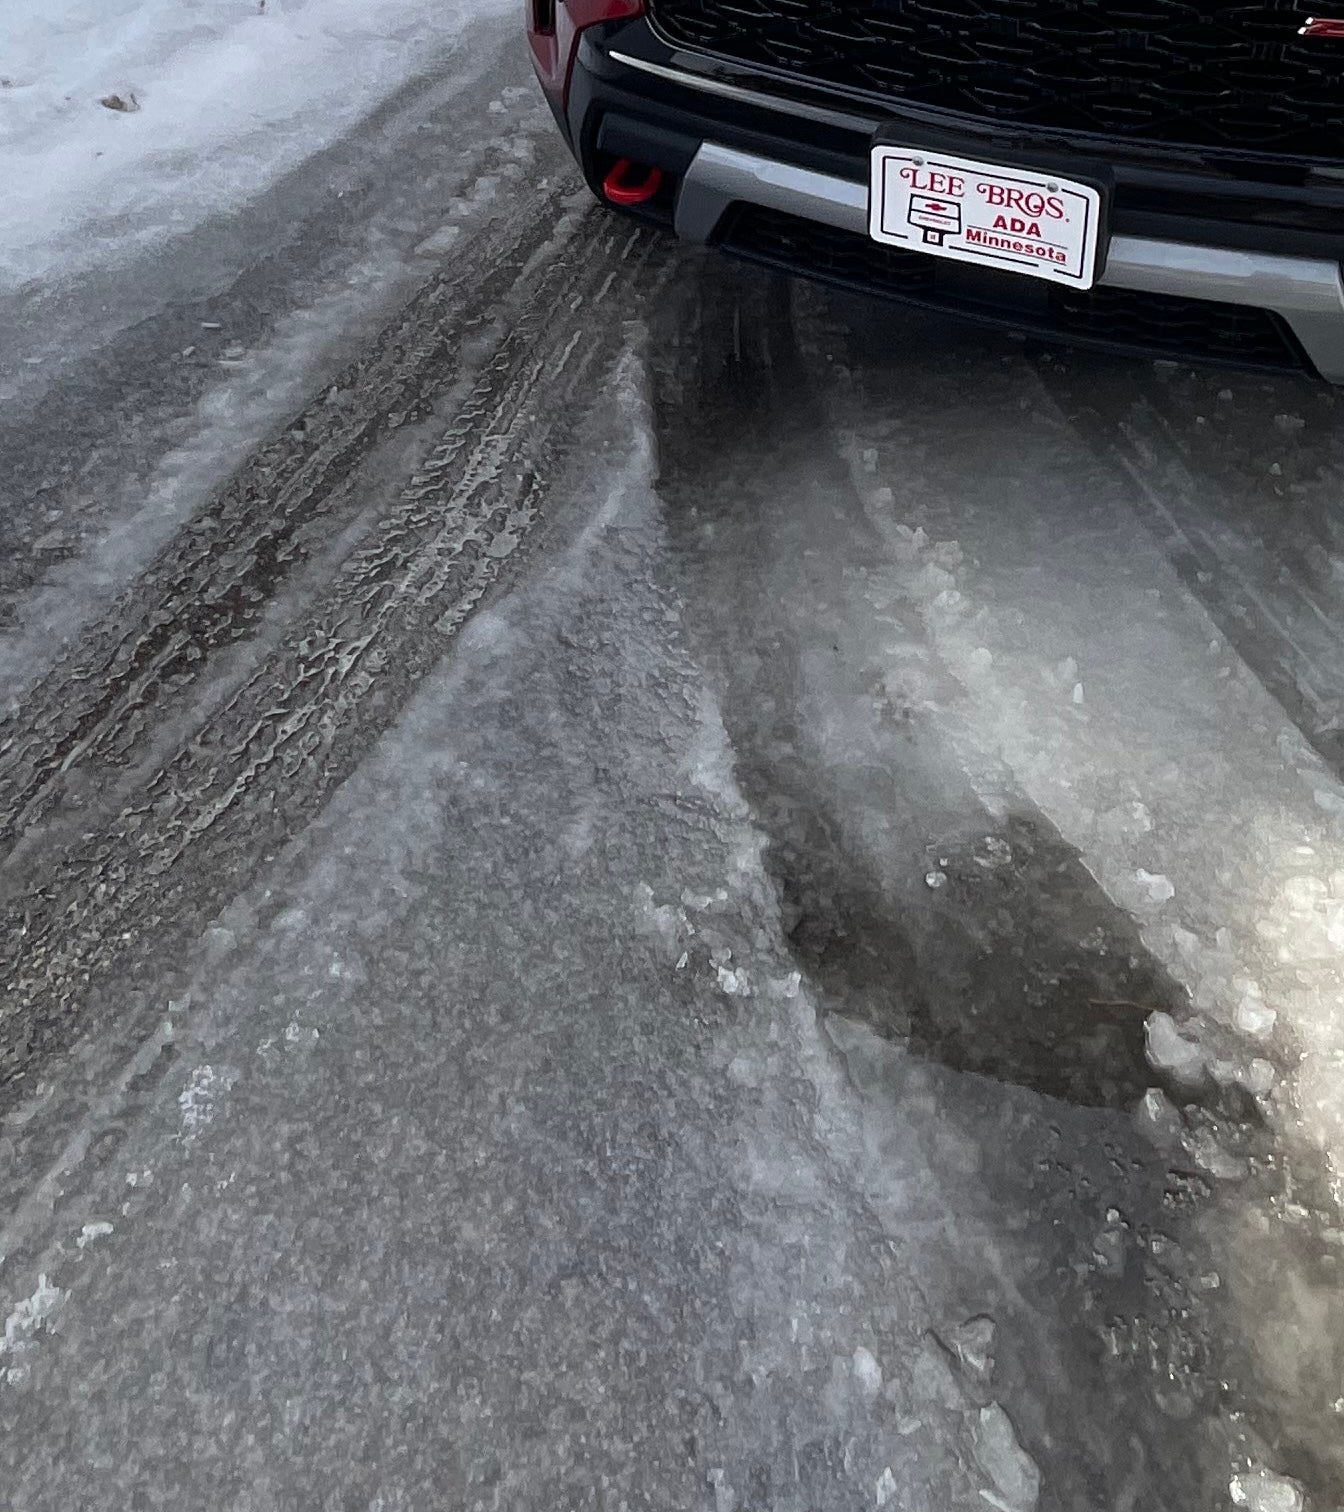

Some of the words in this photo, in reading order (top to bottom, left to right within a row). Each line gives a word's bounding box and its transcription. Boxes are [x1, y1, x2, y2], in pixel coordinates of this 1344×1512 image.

[899, 167, 966, 198] LEE
[992, 215, 1042, 238] ADA
[965, 227, 1067, 263] Minnesota
